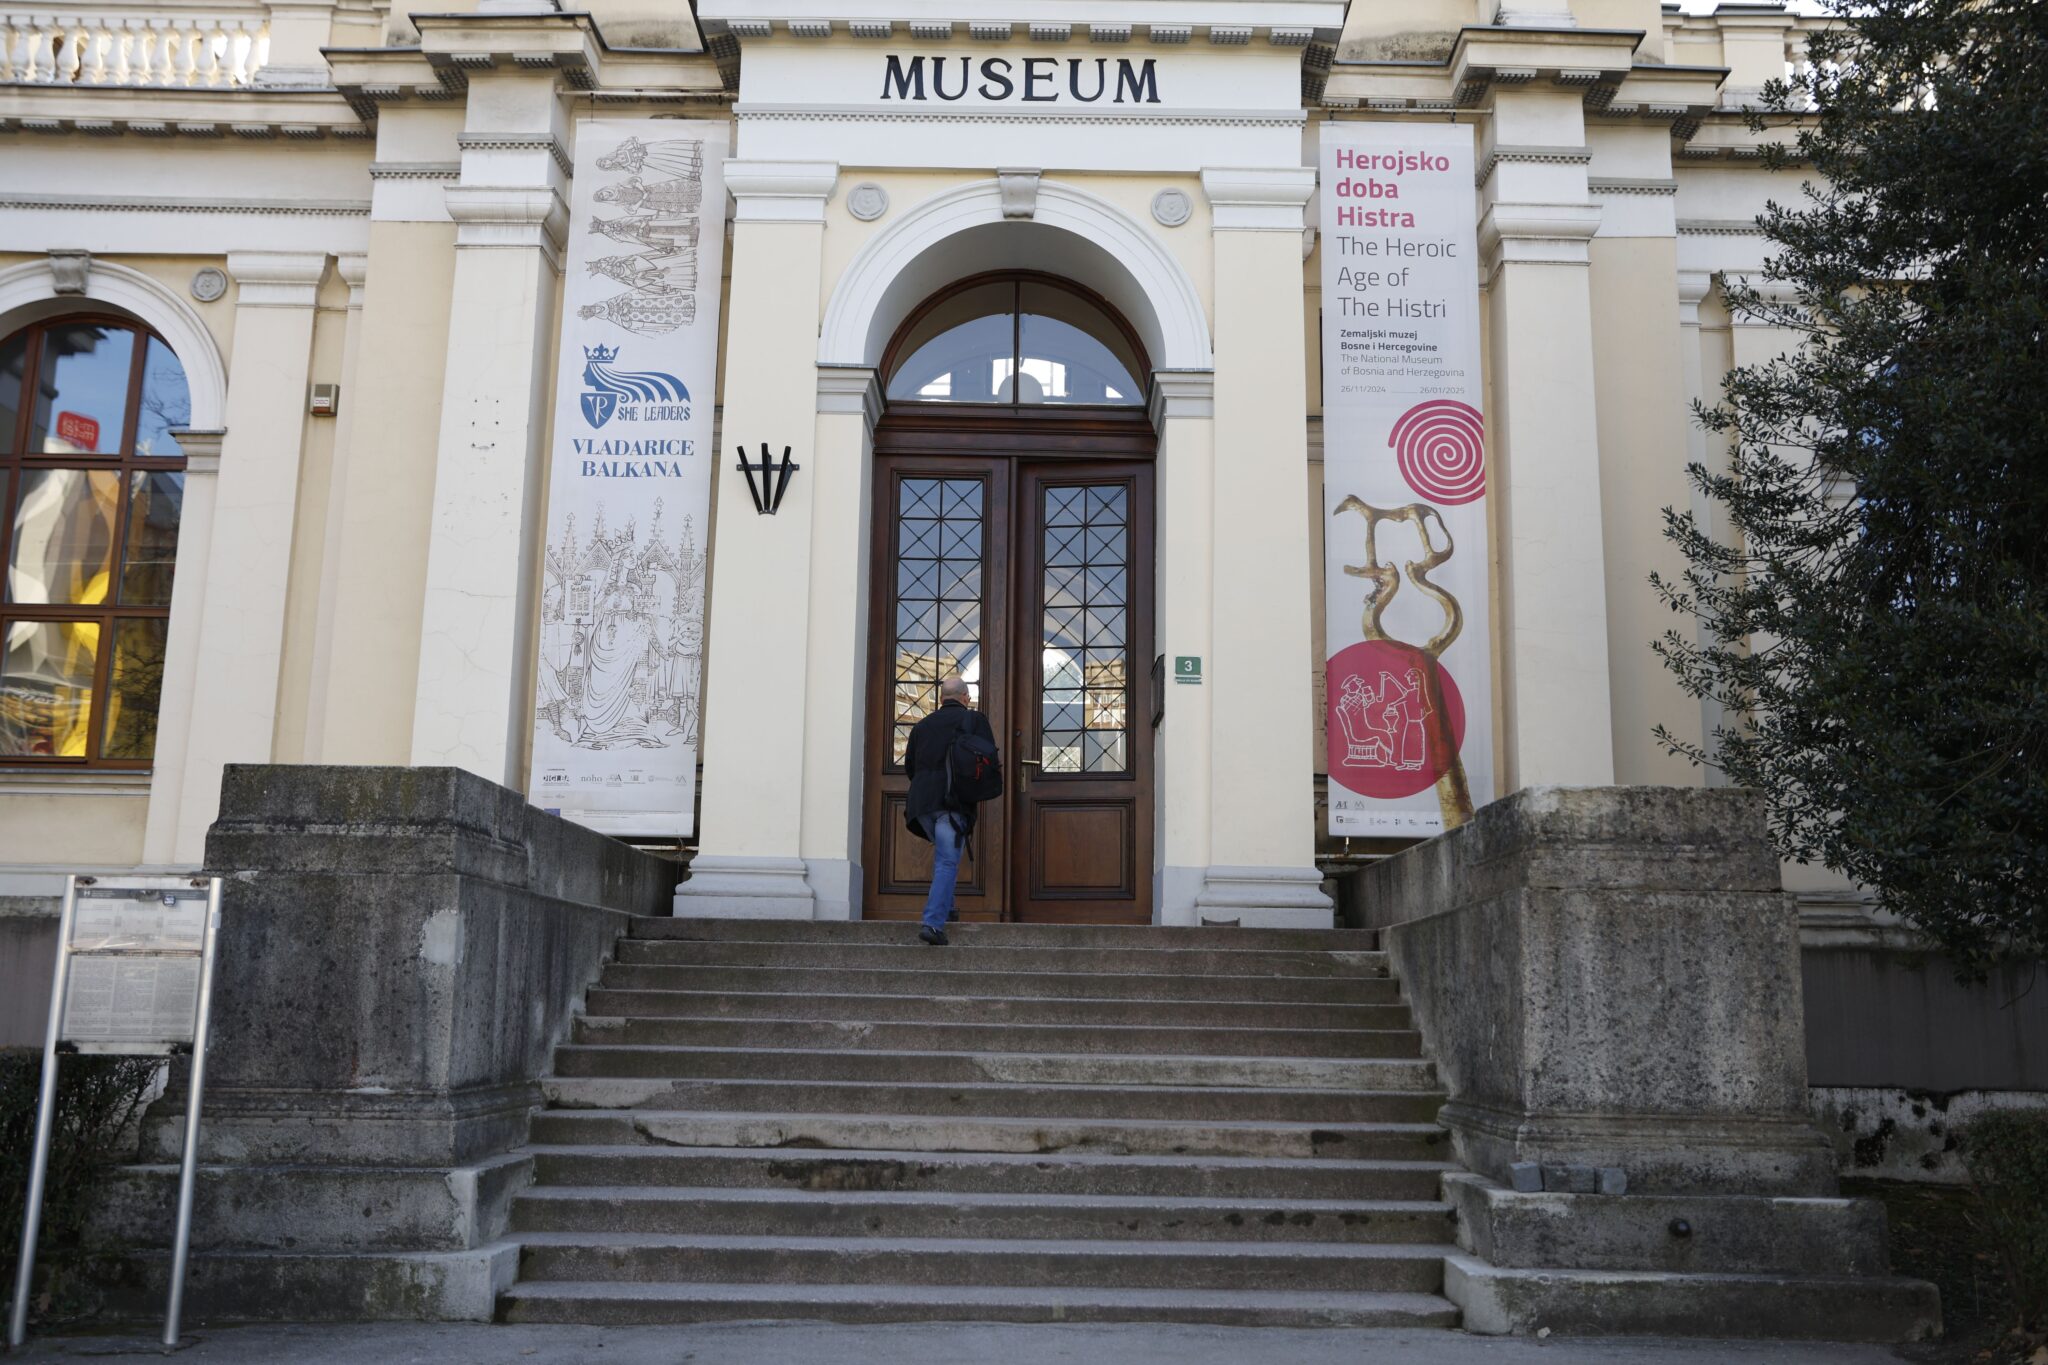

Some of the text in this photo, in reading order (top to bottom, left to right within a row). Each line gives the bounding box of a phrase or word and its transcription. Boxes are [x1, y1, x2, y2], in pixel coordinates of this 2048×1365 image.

[880, 55, 1161, 103] MUSEUM
[1336, 149, 1450, 176] Herojsko
[1336, 177, 1399, 199] doba
[1337, 206, 1416, 228] Histra
[1336, 236, 1457, 257] The Heroic
[1337, 267, 1410, 291] Age of
[1337, 297, 1447, 318] The Histri
[1340, 329, 1418, 340] Zemaljski muzej
[1340, 341, 1371, 351] Bosne
[1378, 342, 1438, 354] Hercegovine
[1341, 354, 1443, 365] The National Museum
[1341, 366, 1465, 379] of Bosnia and Herzegovina
[1340, 384, 1466, 395] 26/11/2024 26/01/2025
[618, 405, 691, 422] SHE LEADERS
[572, 438, 695, 456] VLADARICE
[581, 460, 683, 478] BALKANA
[1184, 660, 1192, 672] 3
